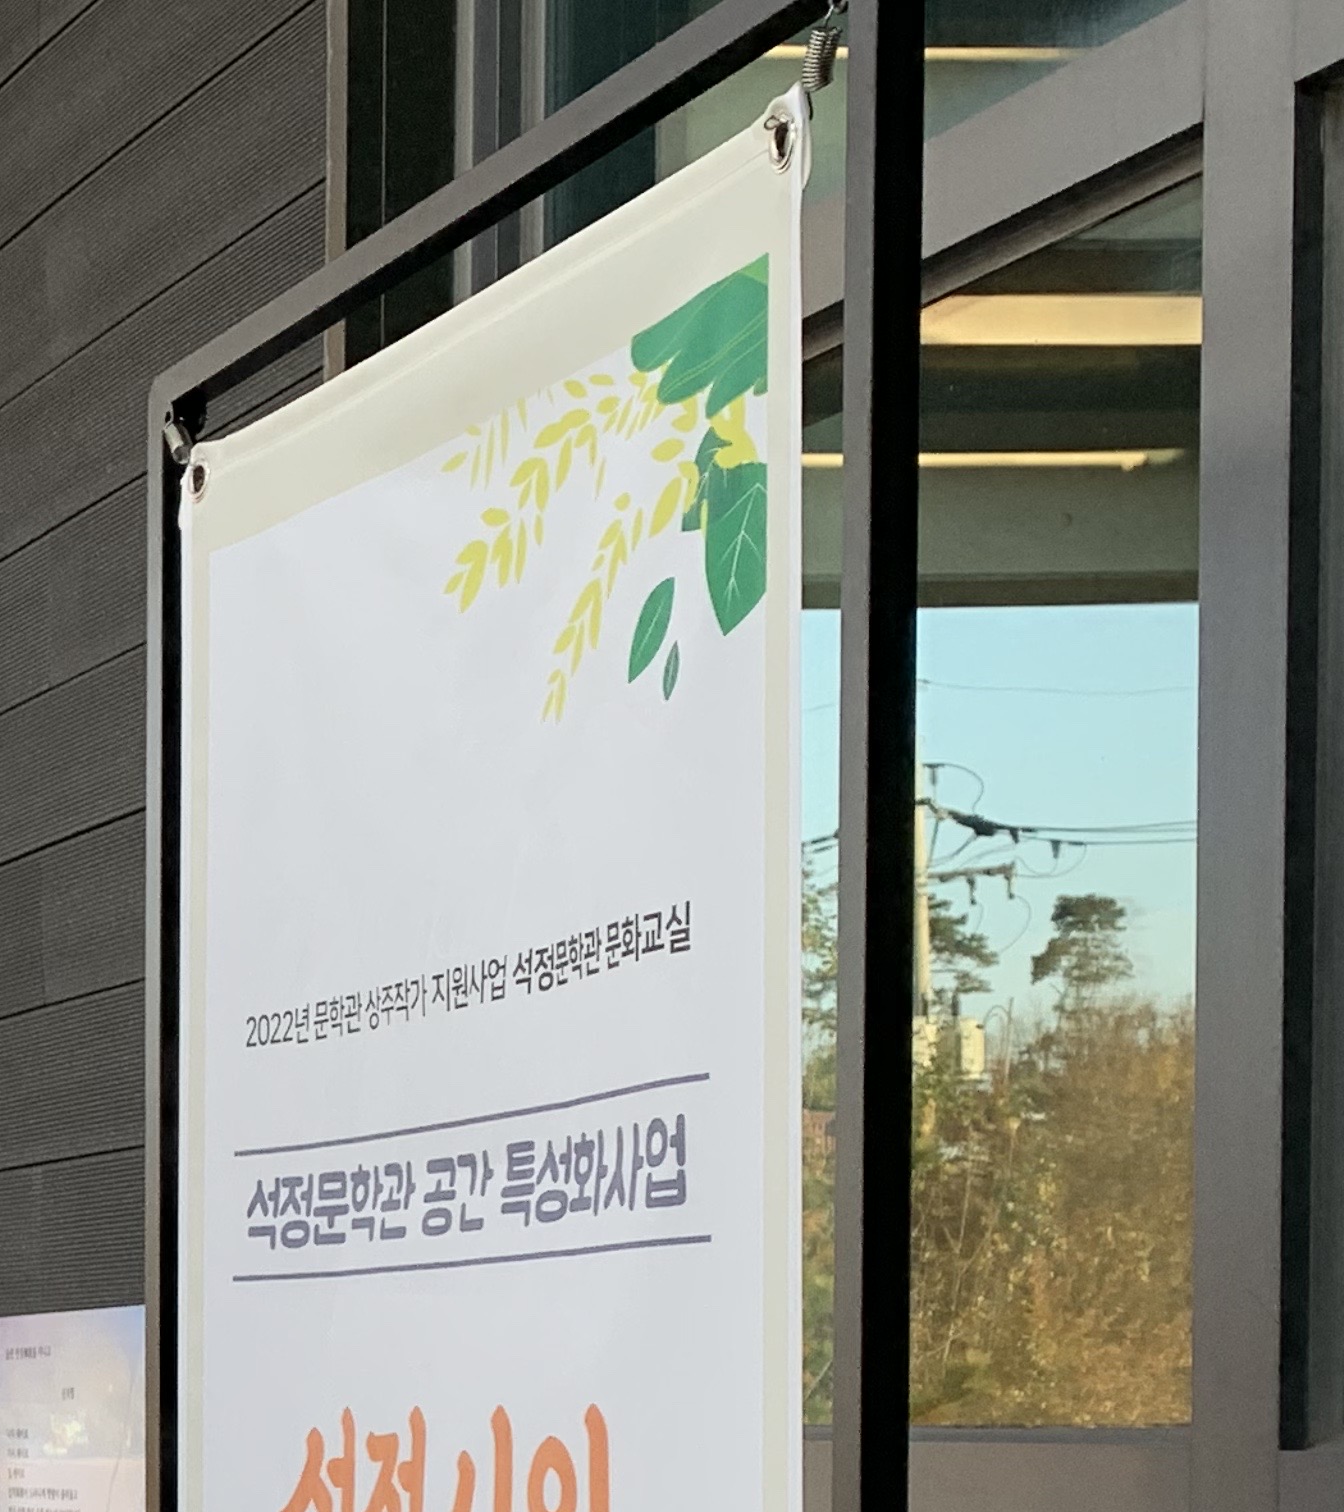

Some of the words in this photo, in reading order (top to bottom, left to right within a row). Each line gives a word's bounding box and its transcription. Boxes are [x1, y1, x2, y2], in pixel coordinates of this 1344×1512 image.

[246, 1002, 309, 1047] 2022년
[313, 992, 362, 1040] 문학관
[365, 974, 427, 1030] 상주작가
[431, 955, 507, 1012] 지원사업
[512, 926, 602, 995] 석정문학관
[604, 900, 691, 970] 문화교실
[247, 1159, 416, 1249] 석정문학관
[422, 1149, 495, 1237] 공간
[500, 1113, 688, 1227] 특성화사업
